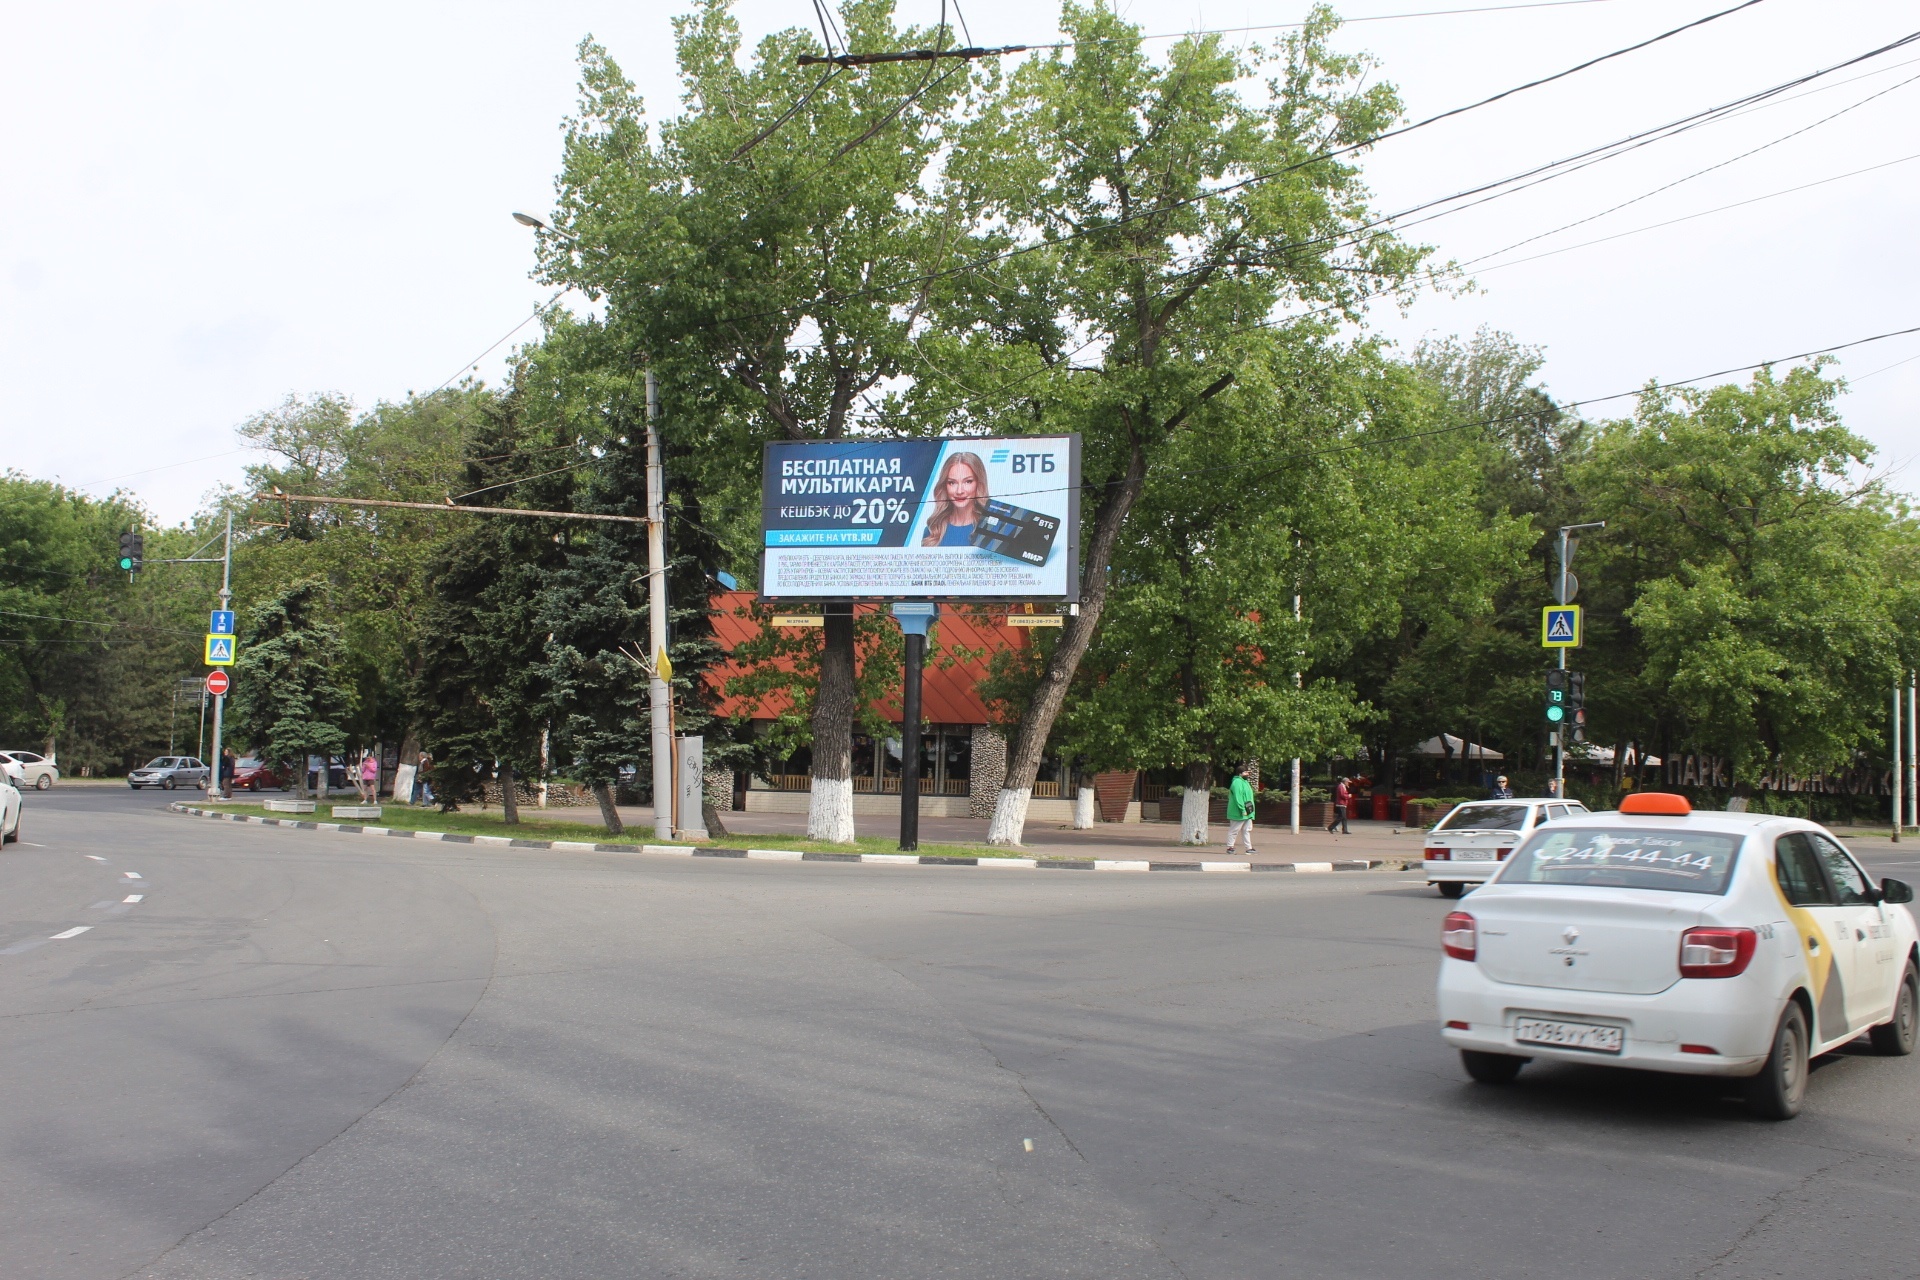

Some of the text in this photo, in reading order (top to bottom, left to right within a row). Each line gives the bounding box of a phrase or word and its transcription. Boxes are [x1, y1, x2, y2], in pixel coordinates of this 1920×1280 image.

[782, 458, 901, 476] БЕСПЛАТНАЯ
[1012, 454, 1055, 473] ВТБ
[781, 476, 915, 494] МУЛЬТИКАРТА
[780, 498, 910, 524] КЕШБЭК ДО 20%
[1039, 519, 1055, 530] ВТБ
[779, 533, 874, 543] ЗАКАЖИТЕ НА VTB.RU
[1022, 550, 1043, 562] МИР
[1550, 690, 1562, 702] 73
[1667, 753, 1726, 788] ПАРК
[1554, 847, 1713, 870] 244-44-44
